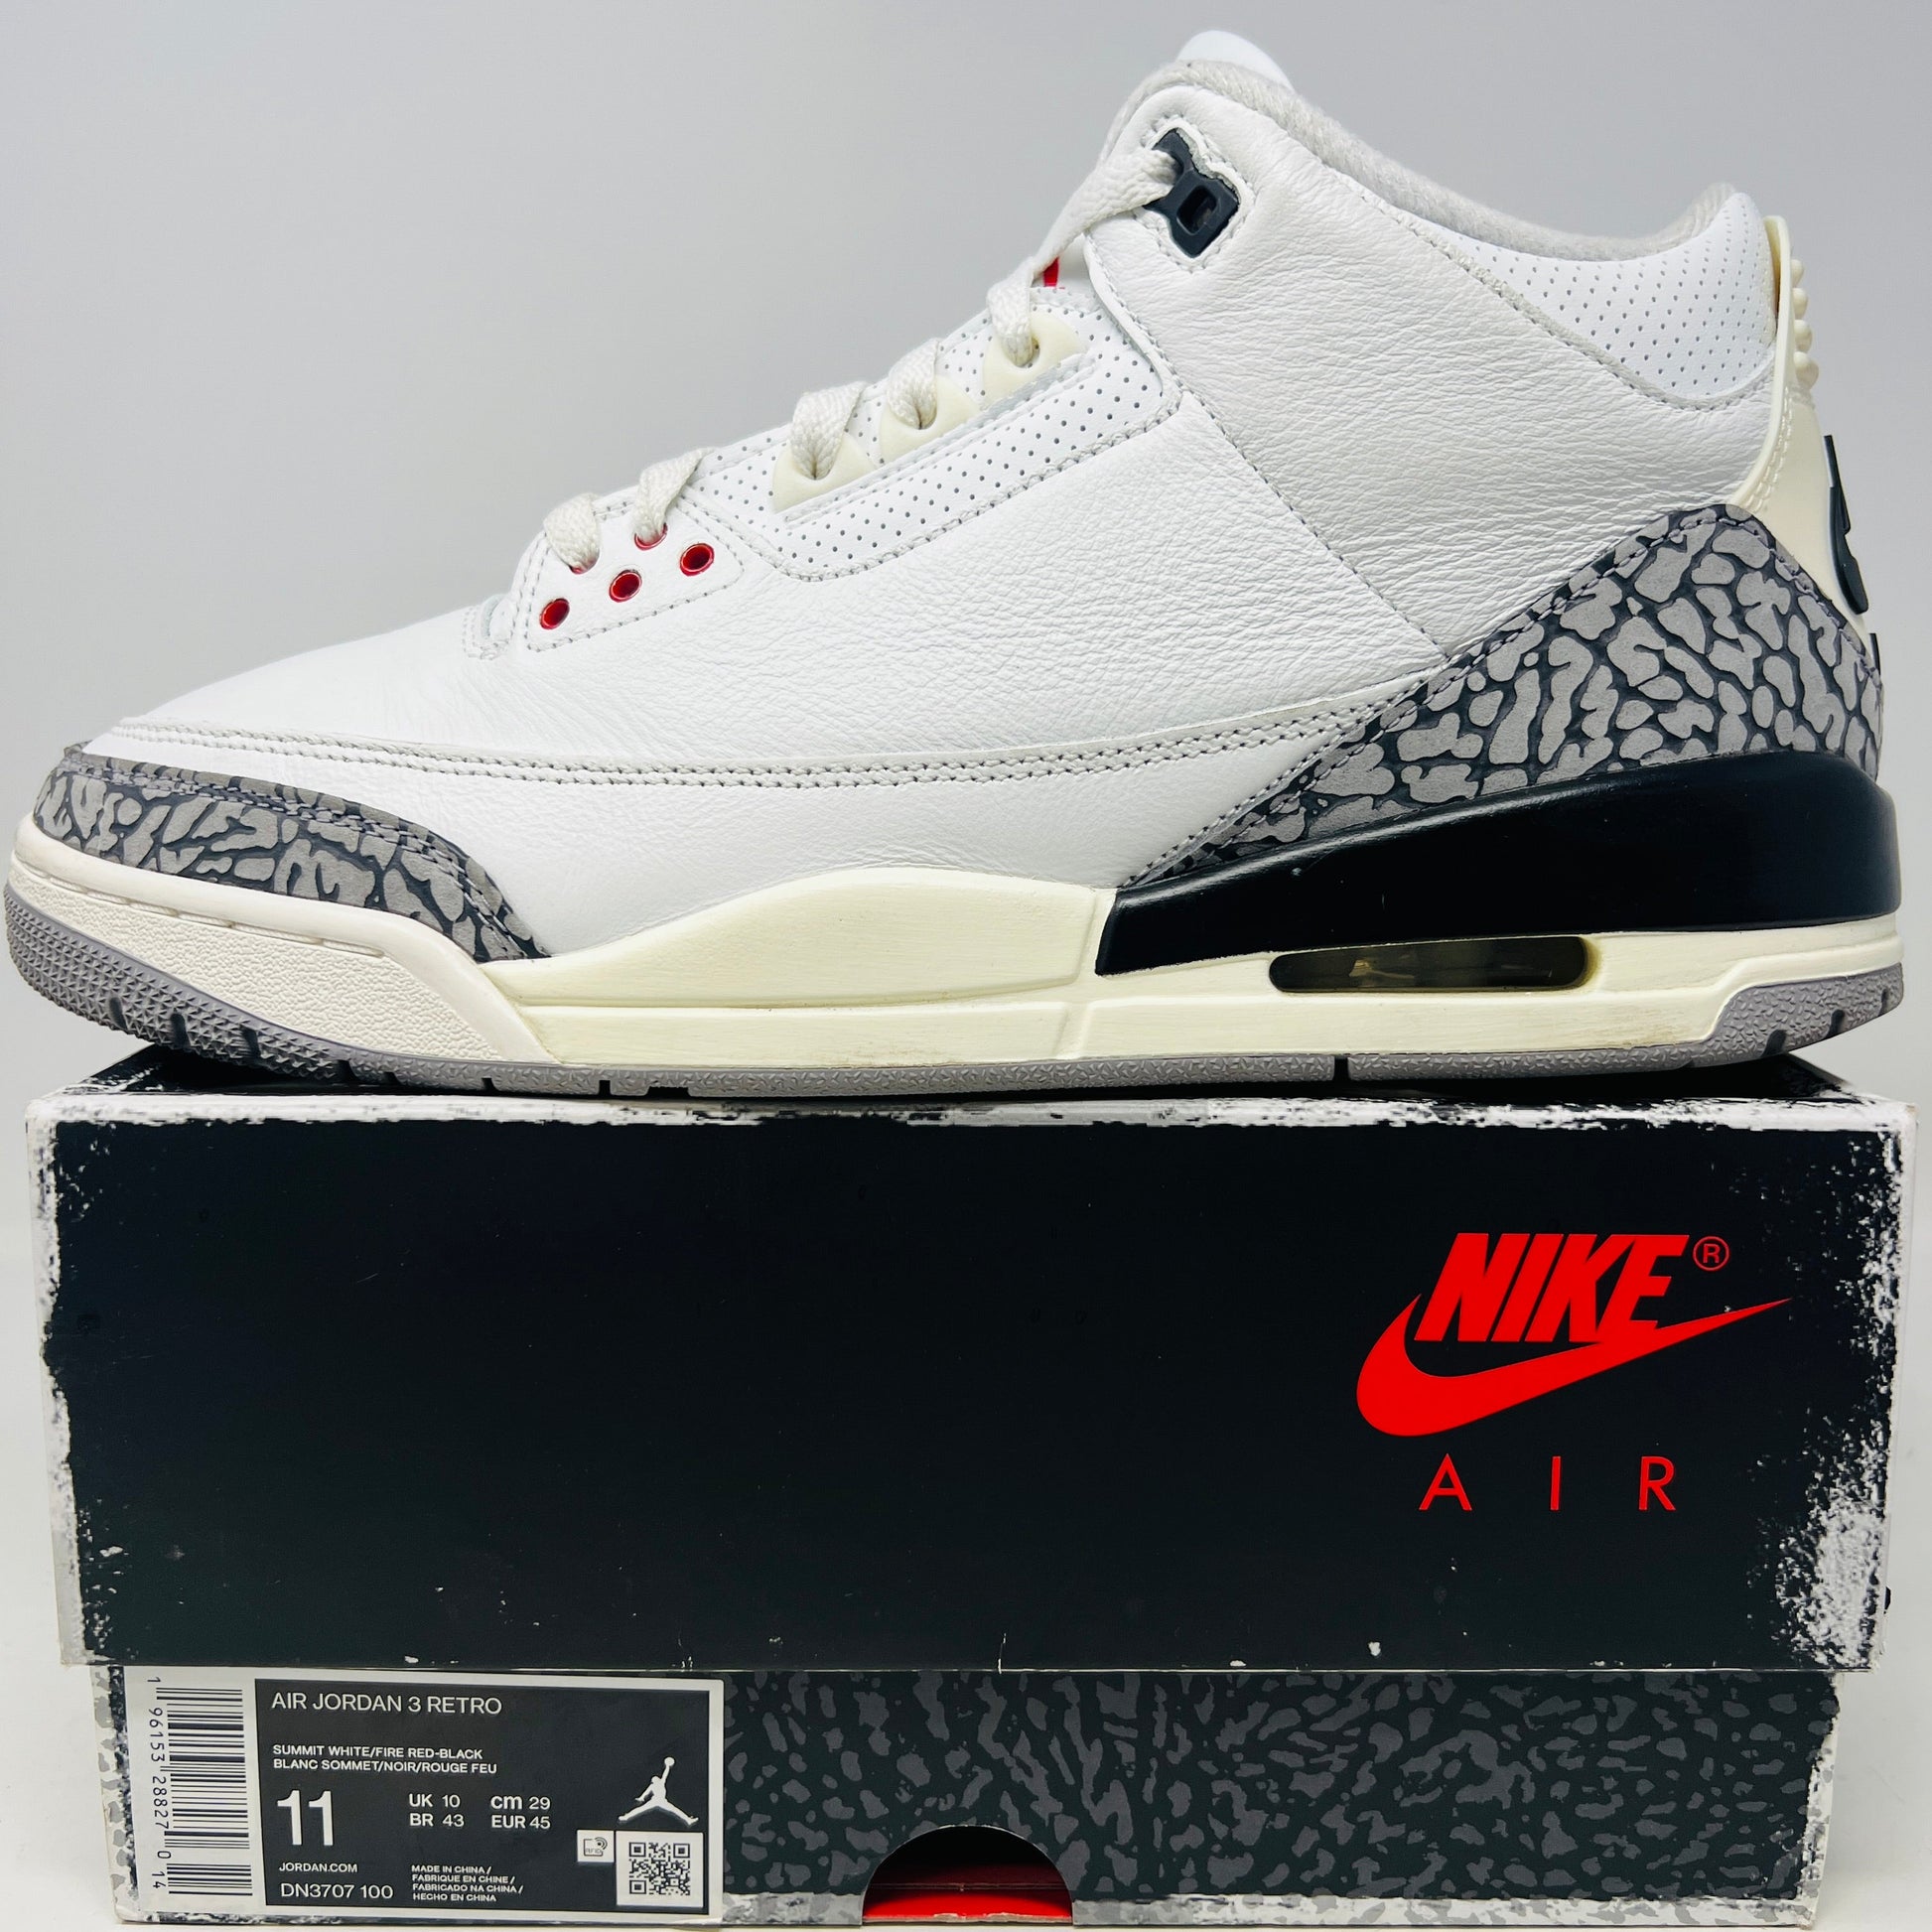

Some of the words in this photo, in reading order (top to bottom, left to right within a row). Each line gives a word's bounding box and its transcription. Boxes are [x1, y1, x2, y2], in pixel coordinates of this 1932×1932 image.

[1414, 1232, 1690, 1343] NIKE
[271, 1692, 308, 1710] AIR
[313, 1693, 402, 1712] JORDAN
[408, 1696, 421, 1713] 3
[427, 1696, 502, 1715] RETRO
[148, 1707, 166, 1763] 96153
[273, 1744, 325, 1756] SUMMIT
[328, 1745, 404, 1758] WHITE/FIRE
[407, 1747, 483, 1759] RED-BLACK
[273, 1758, 319, 1770] BLANC
[321, 1759, 468, 1773] SOMMET/NOIR/ROUGE
[472, 1762, 497, 1774] FEU
[152, 1776, 170, 1830] 28827
[408, 1793, 434, 1808] UK
[441, 1794, 461, 1808] 10
[490, 1795, 523, 1810] cm
[529, 1796, 551, 1811] 29
[277, 1789, 334, 1847] 11
[409, 1813, 434, 1827] BR
[442, 1814, 465, 1828] 43
[491, 1815, 526, 1829] EUR
[529, 1816, 551, 1830] 45
[279, 1862, 357, 1873] JORDAN.COM
[411, 1864, 440, 1873] MADE
[454, 1865, 485, 1874] CHINA
[412, 1873, 461, 1882] FABRIQUE
[463, 1874, 477, 1883] EN
[280, 1882, 354, 1898] DN3707
[359, 1884, 394, 1899] 100
[412, 1882, 469, 1891] FABRICADO
[486, 1884, 517, 1893] CHINA
[413, 1892, 448, 1901] HECHO
[466, 1893, 497, 1902] CHINA
